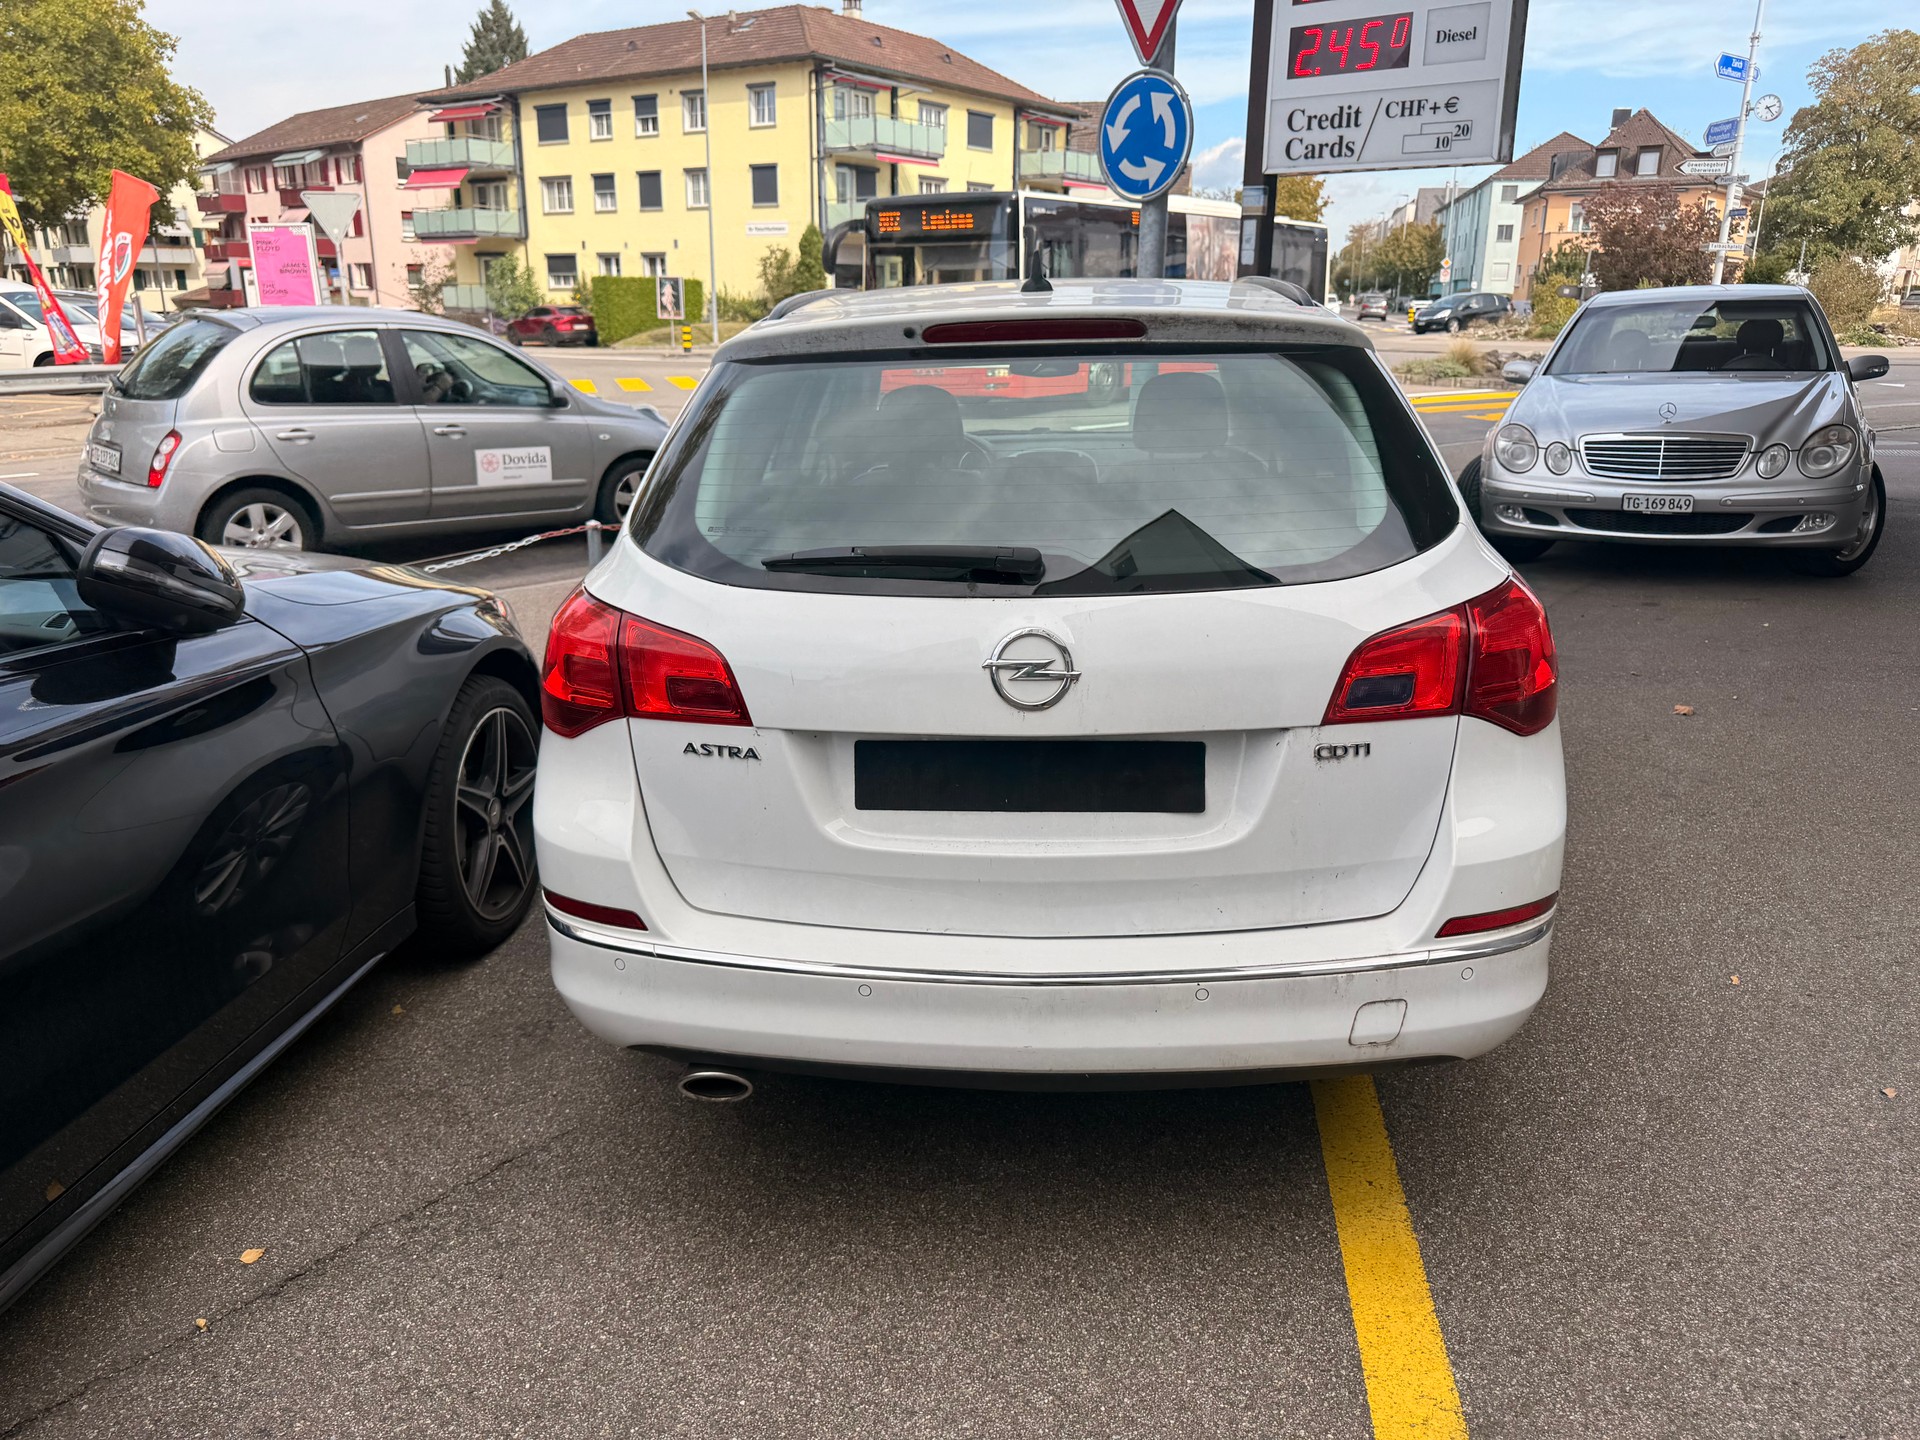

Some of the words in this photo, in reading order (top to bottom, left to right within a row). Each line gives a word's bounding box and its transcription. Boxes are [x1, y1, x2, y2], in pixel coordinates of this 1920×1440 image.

[1435, 26, 1478, 44] Diesel
[1287, 105, 1362, 132] Credit
[1453, 124, 1470, 138] 20
[1285, 135, 1355, 161] Cards
[1435, 136, 1450, 149] 10
[502, 453, 547, 465] Dovida
[683, 742, 762, 761] ASTRA
[1314, 742, 1371, 761] CDTI
